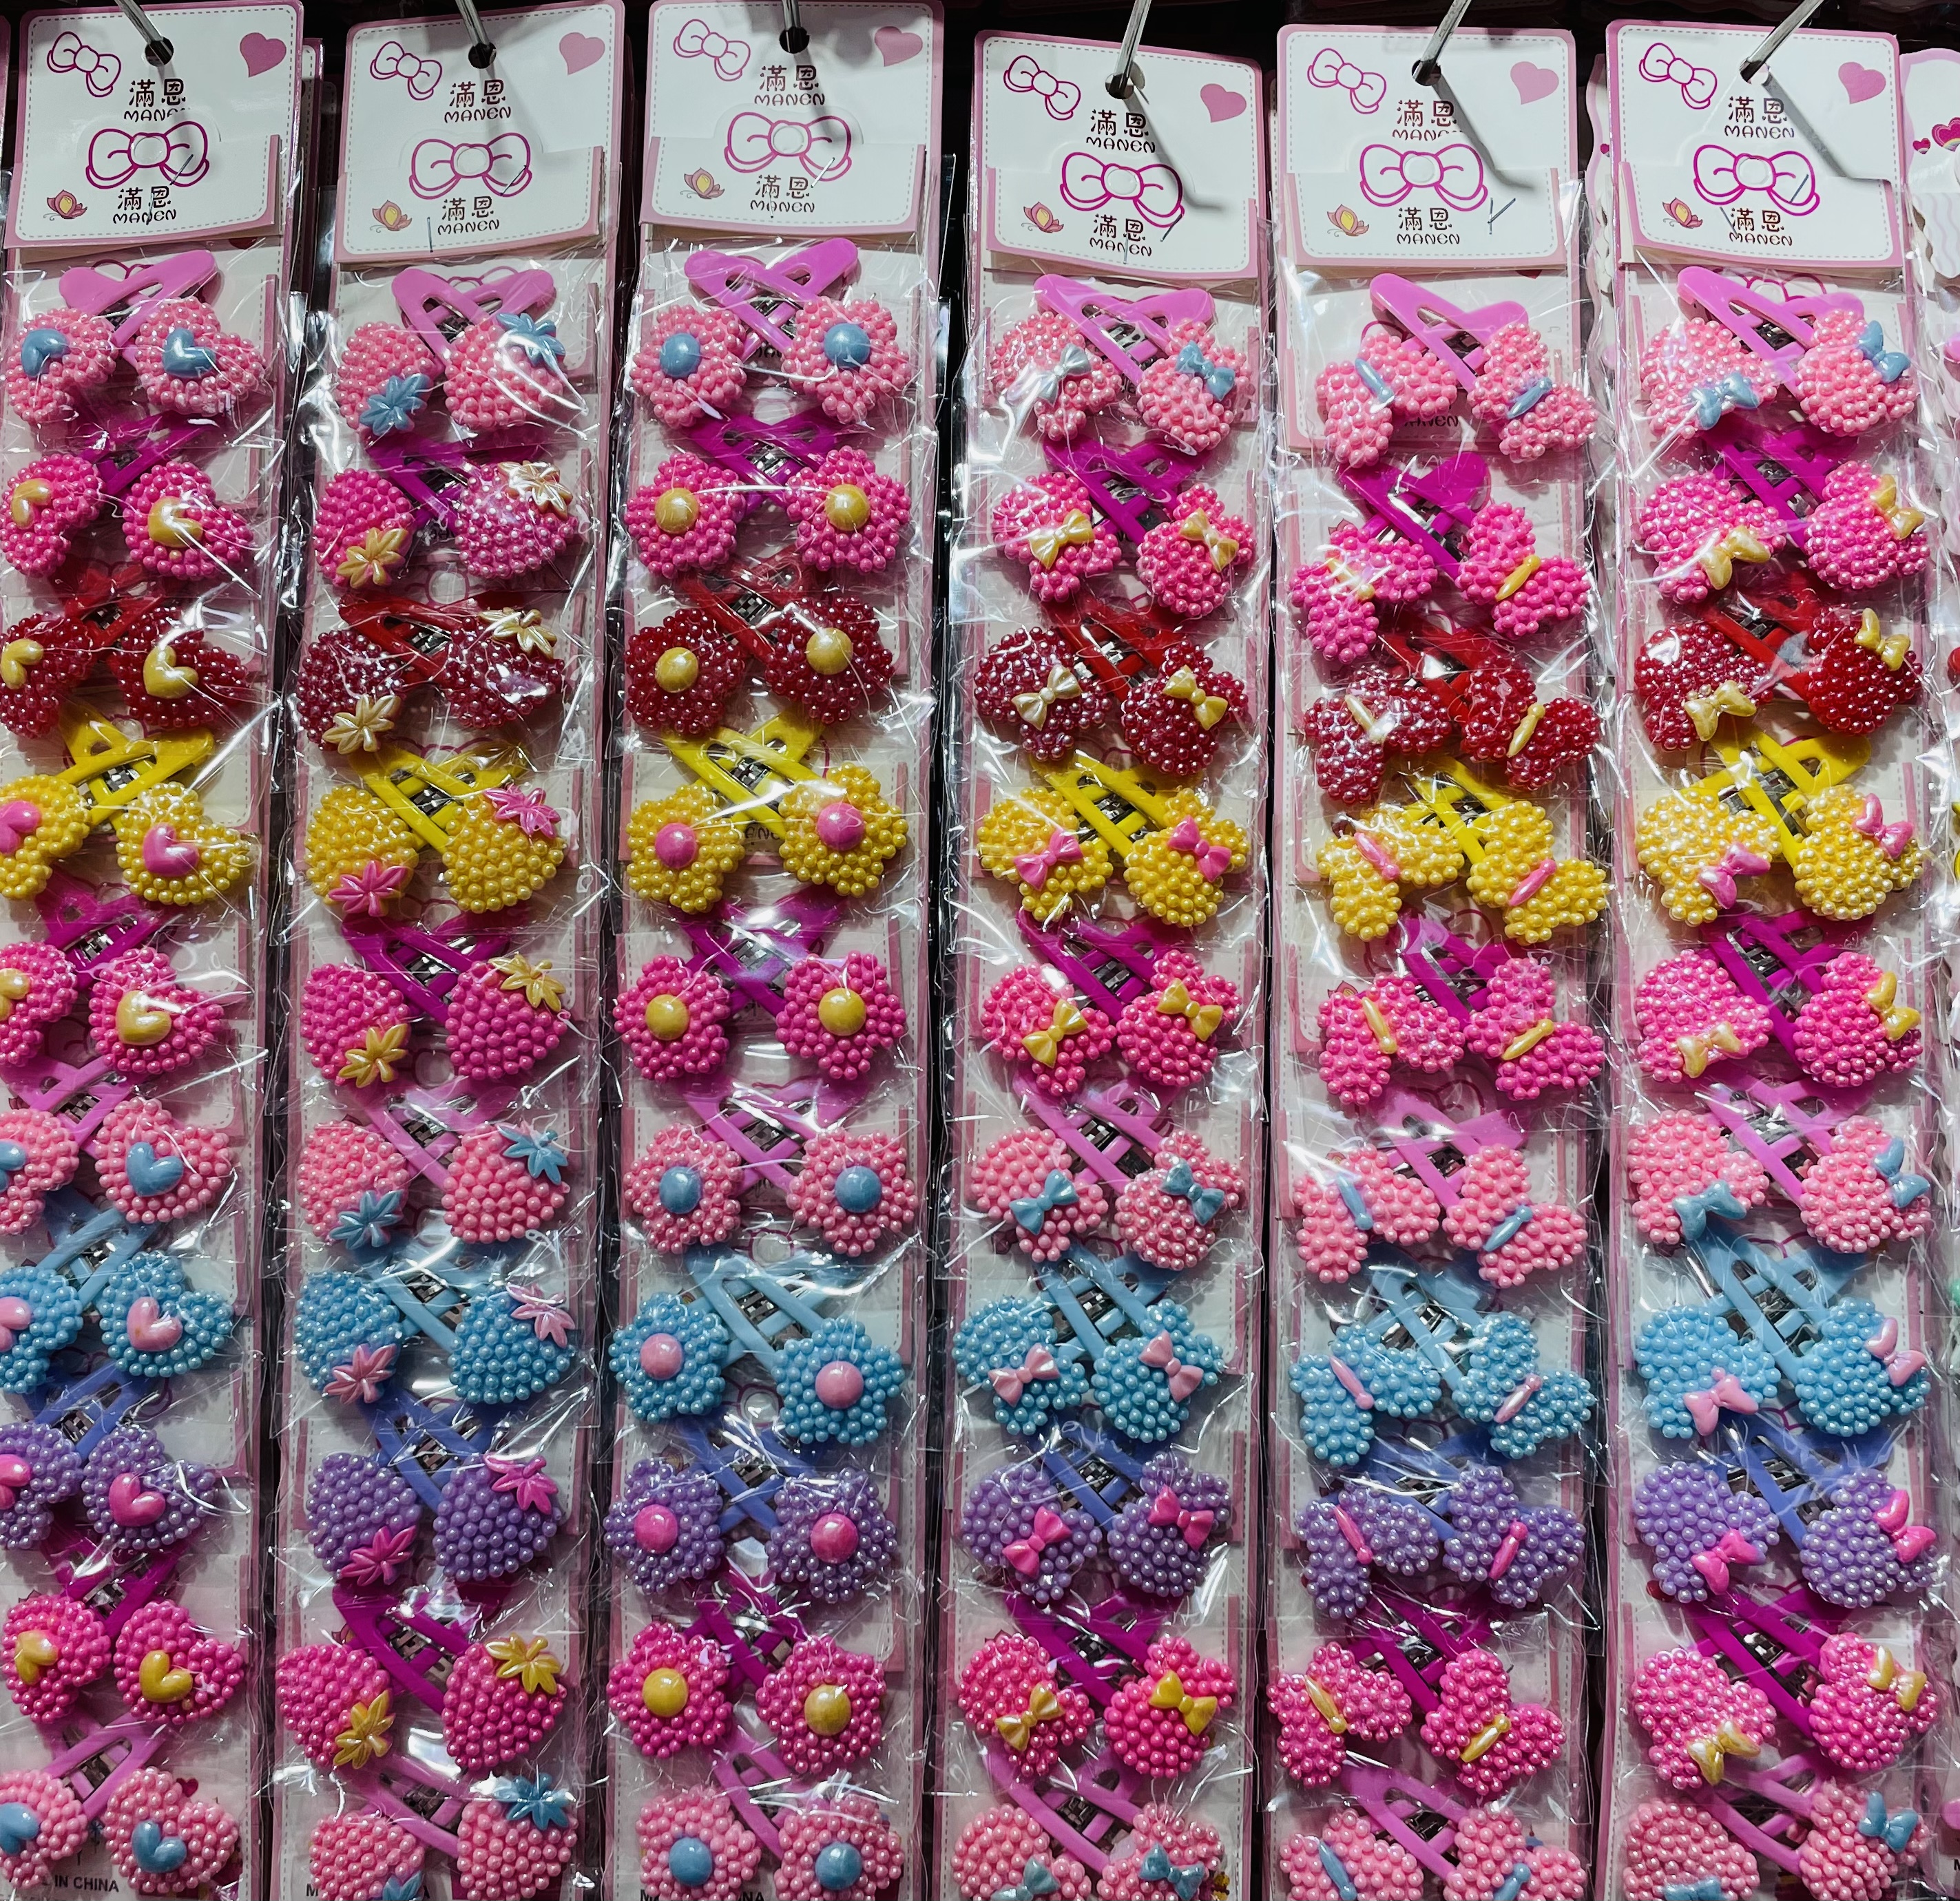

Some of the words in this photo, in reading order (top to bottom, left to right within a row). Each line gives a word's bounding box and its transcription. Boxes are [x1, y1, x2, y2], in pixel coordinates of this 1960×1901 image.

[760, 65, 819, 91] 滿恩
[129, 78, 186, 107] 滿恩
[450, 79, 505, 107] 滿恩
[755, 93, 825, 105] MANEN
[124, 107, 191, 123] MAN
[444, 105, 511, 123] MANEN
[1397, 100, 1458, 127] 滿恩
[1729, 96, 1786, 123] 滿恩
[1090, 109, 1149, 138] 滿恩
[1724, 125, 1794, 138] MANEN
[1393, 129, 1463, 140] MAN
[1086, 136, 1156, 154] MANEN
[755, 174, 811, 198] 滿恩
[118, 185, 171, 210] 滿恩
[751, 200, 814, 212] MANEN
[113, 209, 176, 224] MANEN
[441, 196, 494, 221] 滿恩
[438, 218, 499, 235] MANEN
[1094, 213, 1146, 241] 滿恩
[1398, 207, 1454, 231] 滿恩
[1731, 207, 1784, 231] 滿恩
[1090, 238, 1152, 257] MANEN
[1397, 233, 1459, 244] MANEN
[1729, 232, 1792, 246] MANEN
[55, 1874, 68, 1888] IN
[73, 1876, 119, 1893] CHINA
